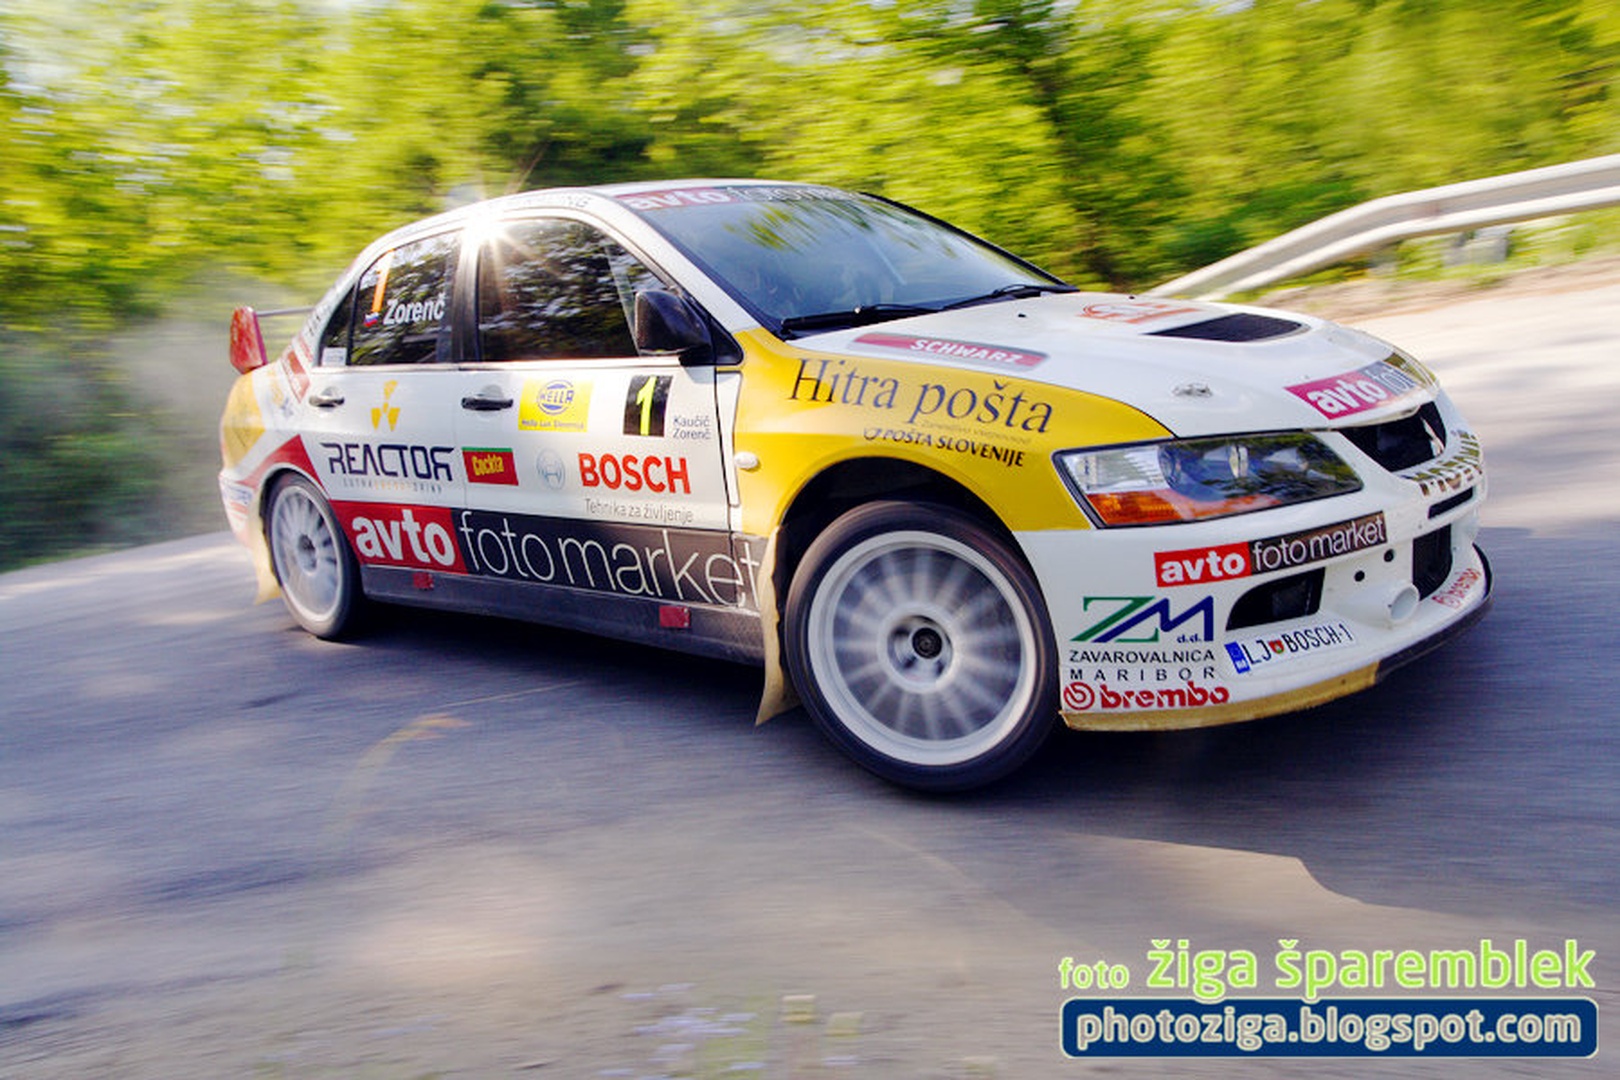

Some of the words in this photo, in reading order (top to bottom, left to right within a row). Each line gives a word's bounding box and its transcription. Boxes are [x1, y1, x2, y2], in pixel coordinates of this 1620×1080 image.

[910, 338, 1025, 364] SCHWARZ
[540, 389, 575, 404] HELLA
[636, 375, 657, 436] 1
[789, 357, 900, 410] Hitra
[906, 379, 1053, 433] pošta
[1306, 379, 1388, 414] avto
[320, 442, 455, 482] REACTOR
[880, 427, 932, 447] POŠTA
[936, 432, 1026, 468] SLOVENIJE
[578, 453, 692, 495] BOSCH
[585, 498, 627, 517] Tehnika
[628, 505, 642, 517] za
[643, 502, 694, 525] življenje
[352, 509, 456, 567] avto
[1161, 550, 1246, 584] avto
[1069, 595, 1215, 643] ZM
[1069, 649, 1216, 664] ZAVAROVALNICA
[1242, 639, 1272, 665] LJ
[1069, 666, 1216, 682] MARIBOR
[1099, 680, 1230, 709] brembo
